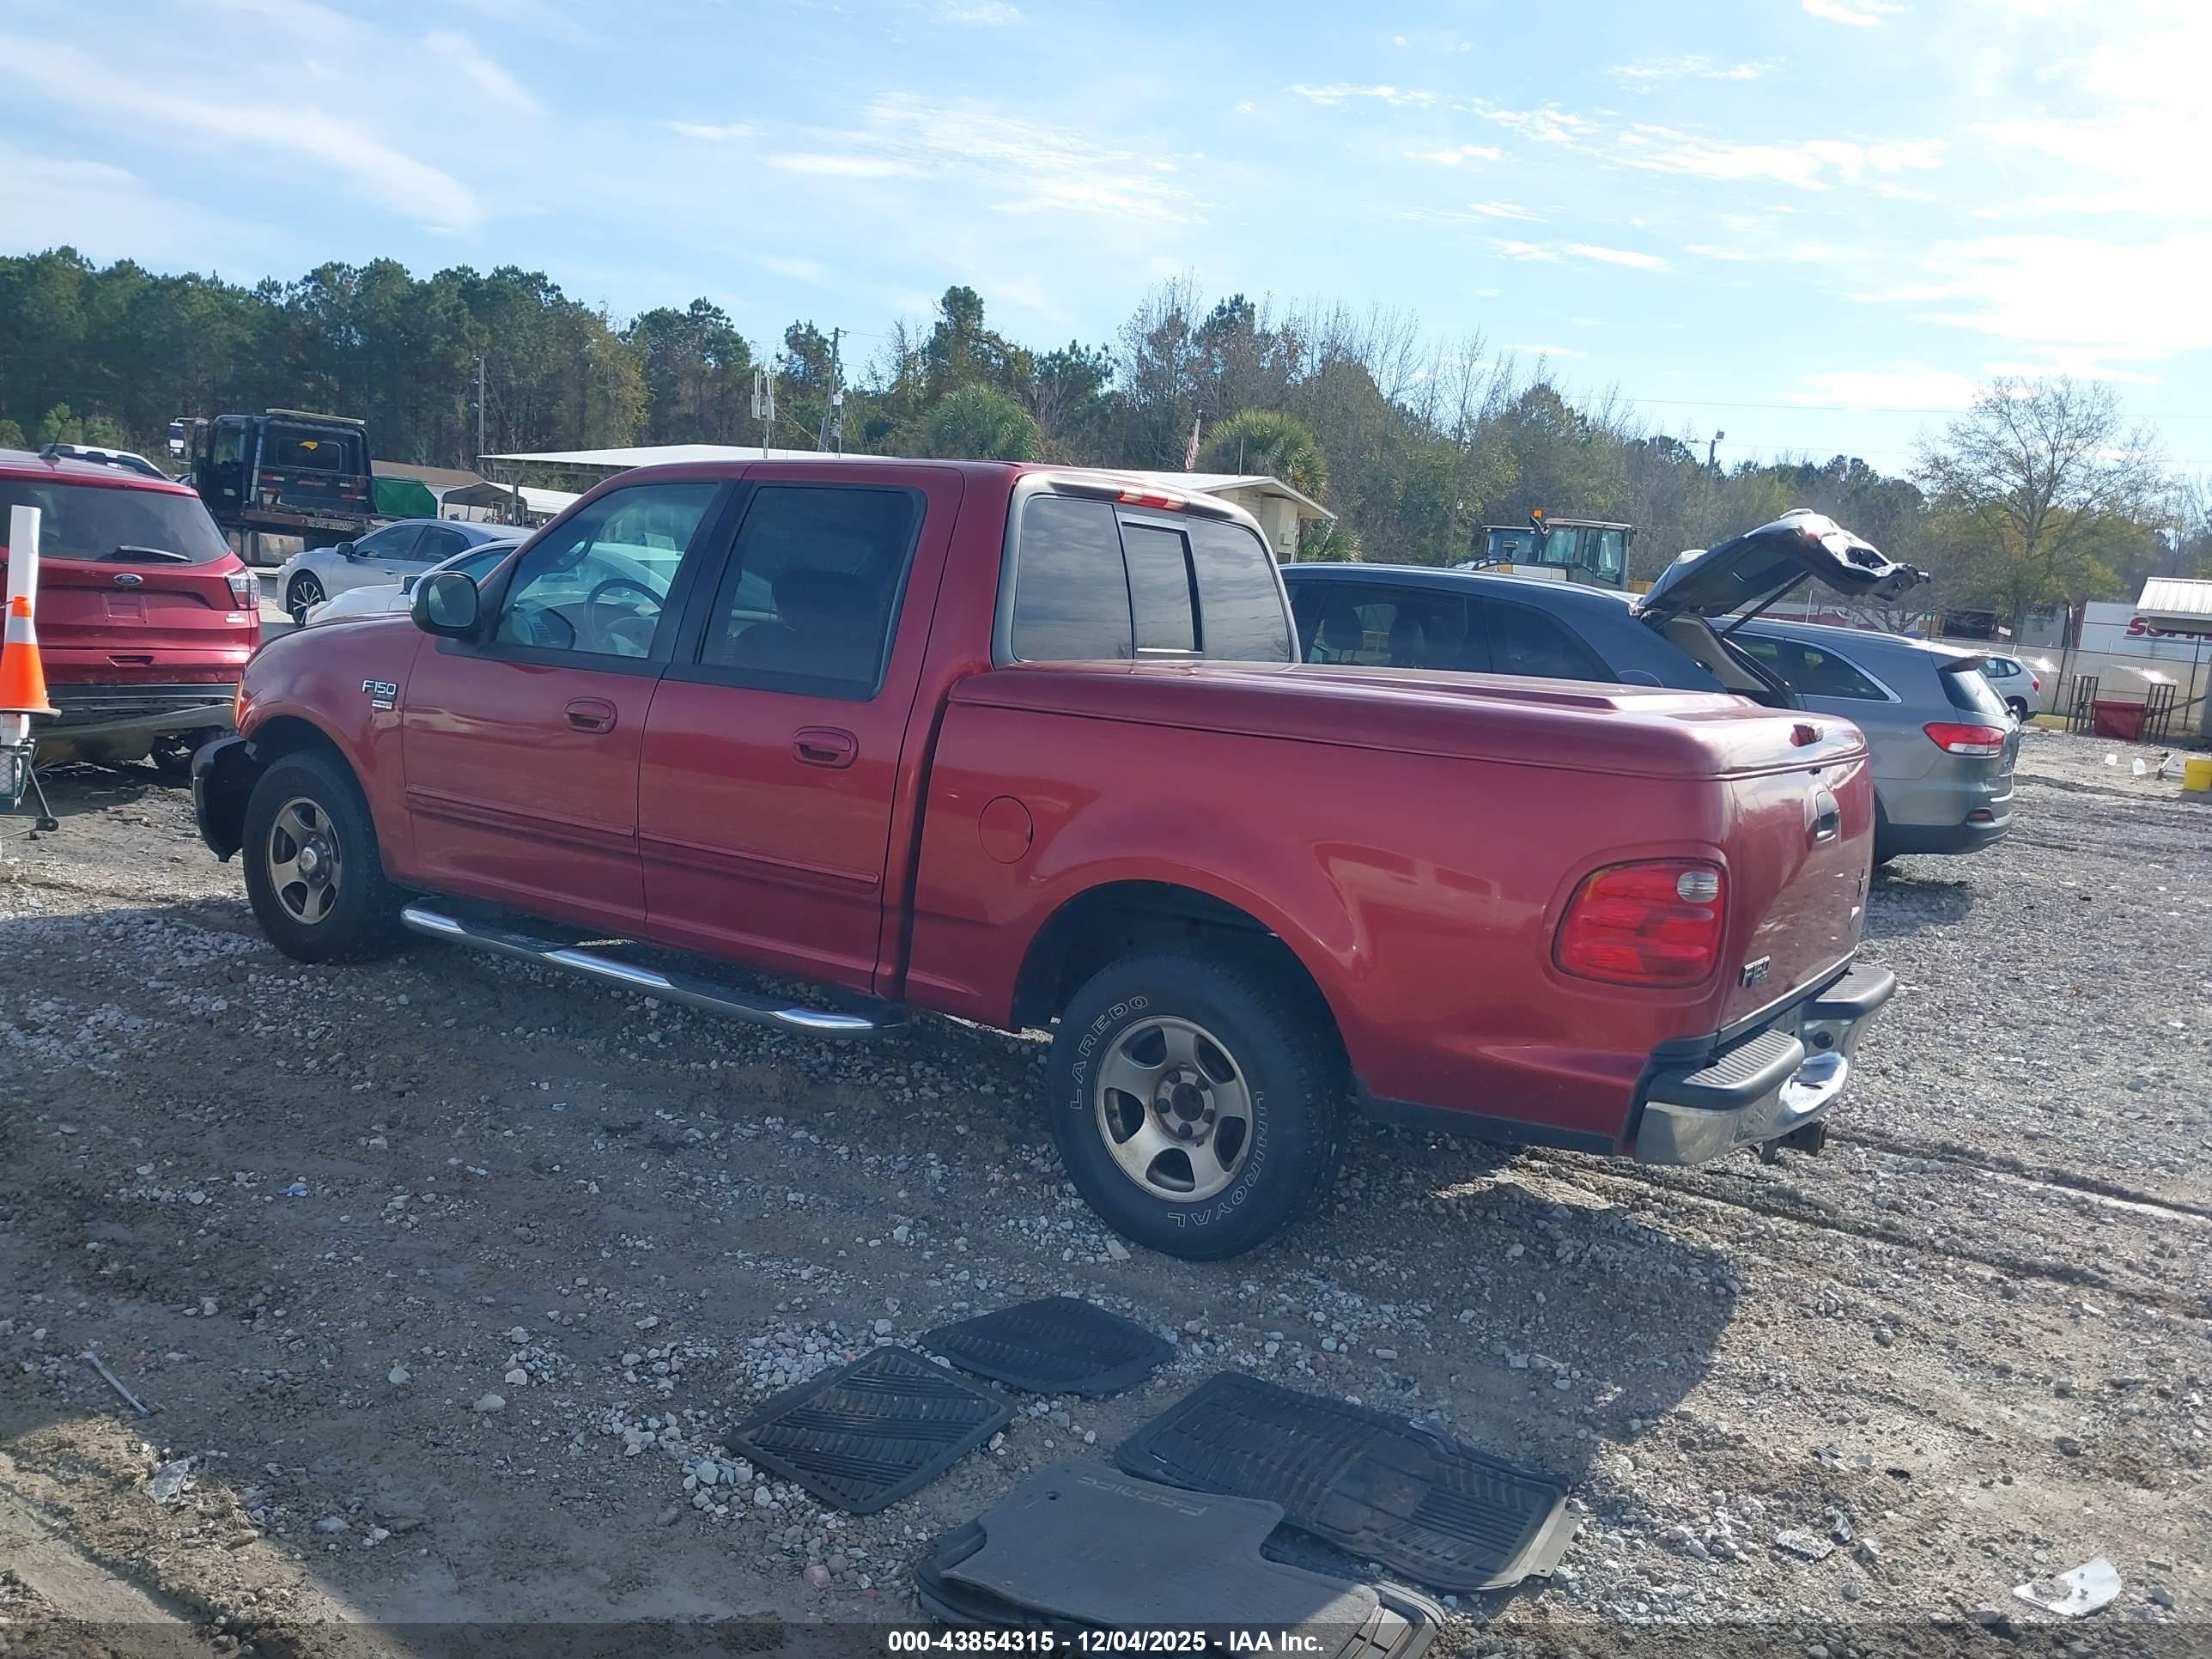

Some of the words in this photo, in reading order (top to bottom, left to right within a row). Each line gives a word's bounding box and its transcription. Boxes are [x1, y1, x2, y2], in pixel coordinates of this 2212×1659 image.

[362, 679, 398, 696] F150
[1069, 995, 1149, 1109] LAREDO
[1167, 1091, 1268, 1229] UNIROYAL
